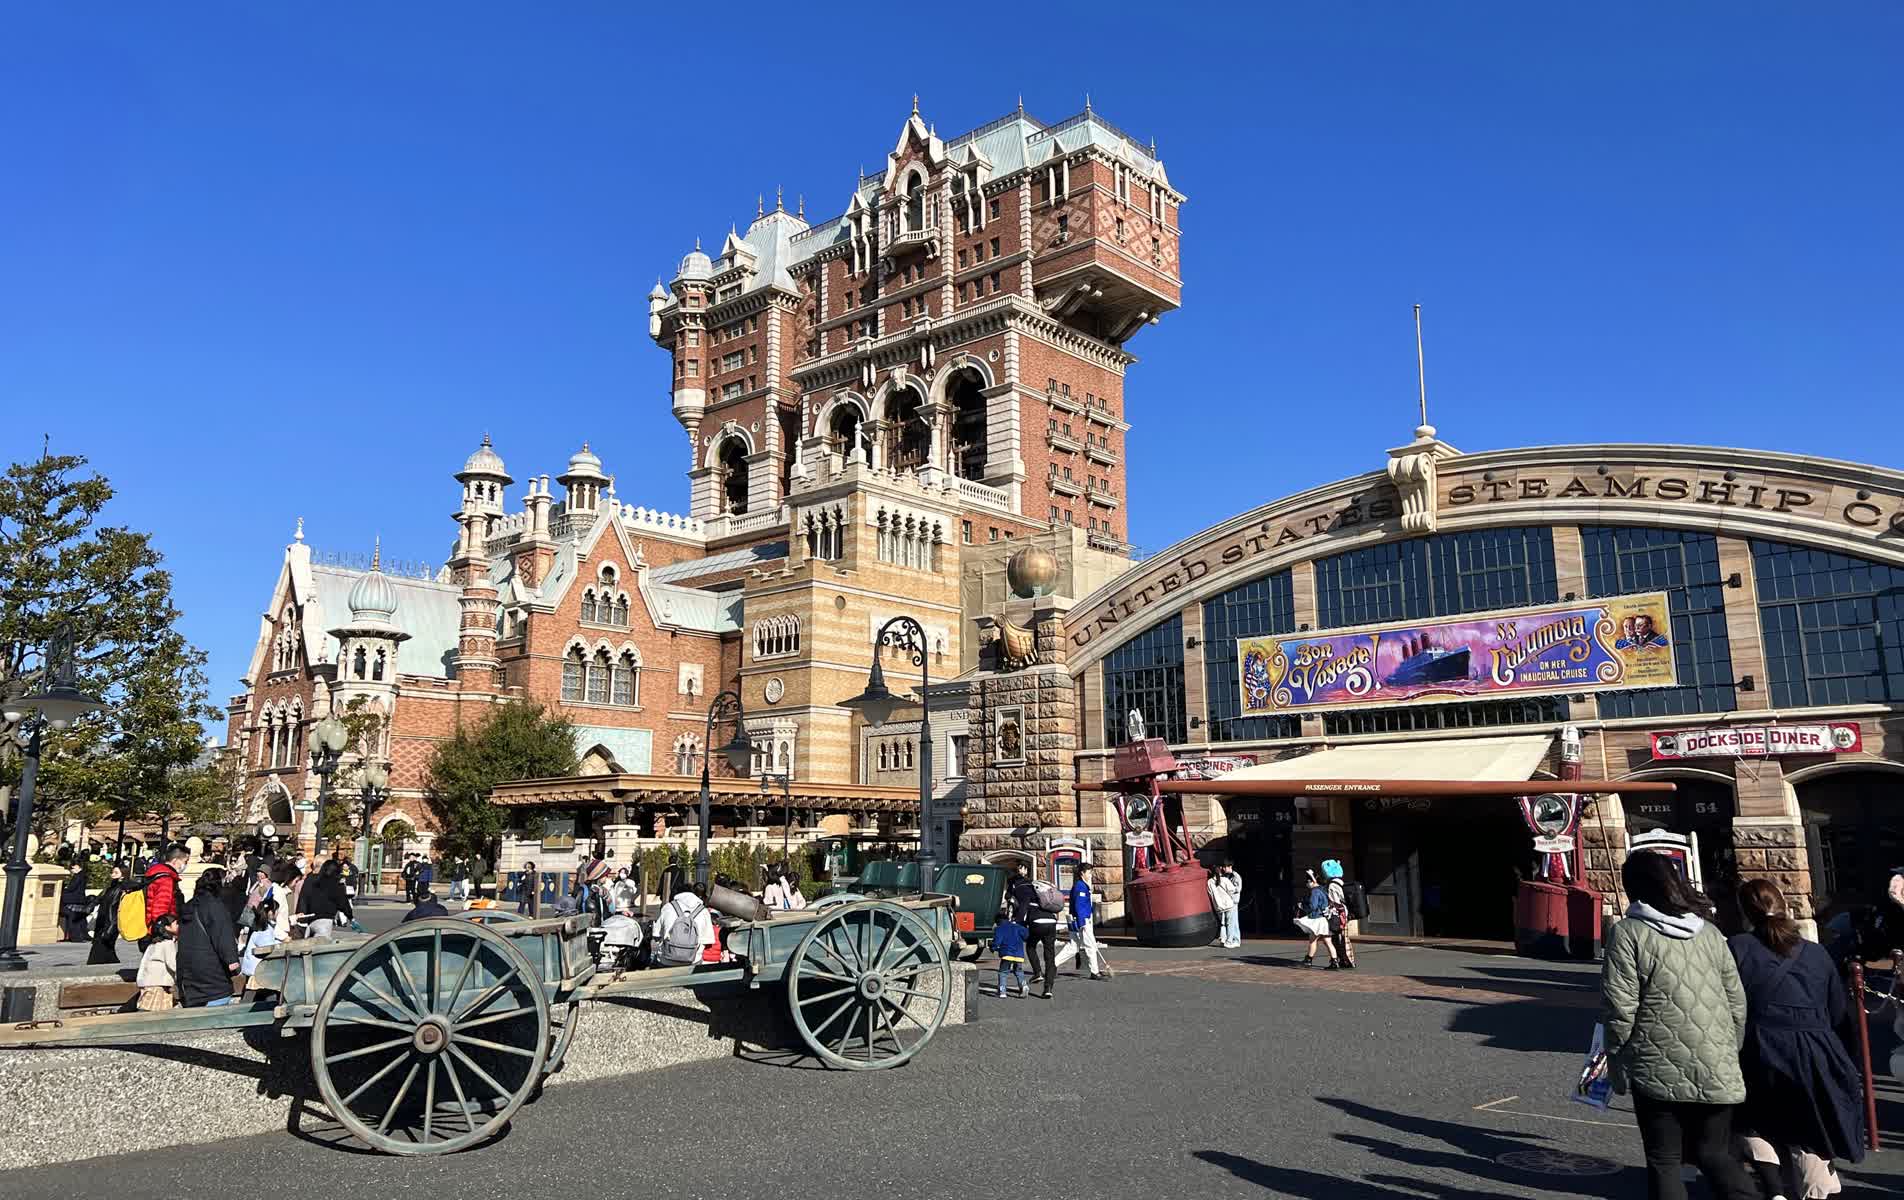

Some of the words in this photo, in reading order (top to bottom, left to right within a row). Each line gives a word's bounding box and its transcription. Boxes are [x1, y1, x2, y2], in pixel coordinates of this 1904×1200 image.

[1071, 561, 1209, 647] UNITED
[1222, 499, 1395, 564] STATES
[1449, 476, 1815, 512] STEAMSHIP
[1296, 643, 1333, 666] Bon
[1540, 662, 1550, 670] ON
[1551, 660, 1566, 669] HER
[1520, 672, 1560, 682] INAUGURAL
[1561, 668, 1588, 678] CRUISE
[1687, 732, 1765, 751] DOCKSIDE
[1770, 731, 1821, 746] DINER
[1640, 805, 1672, 813] PIER
[1696, 802, 1719, 813] 54
